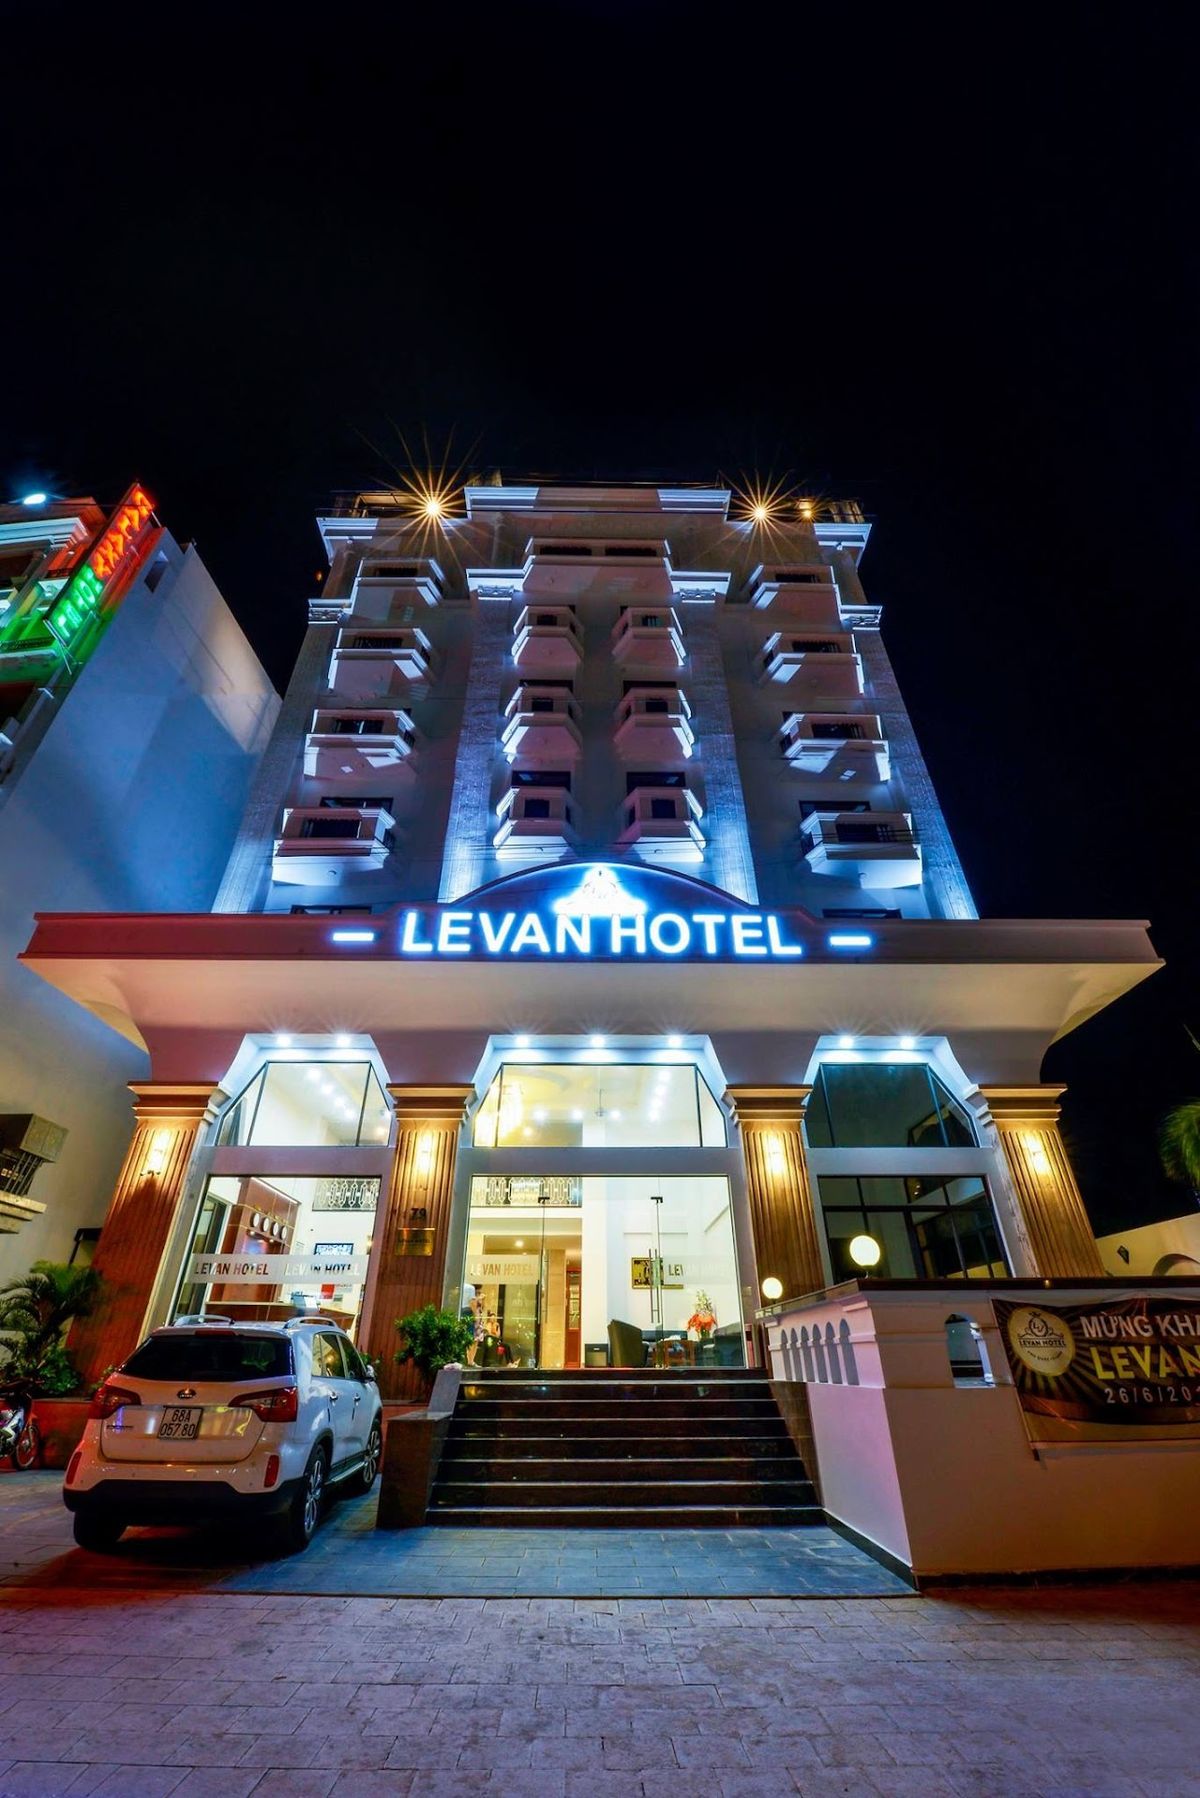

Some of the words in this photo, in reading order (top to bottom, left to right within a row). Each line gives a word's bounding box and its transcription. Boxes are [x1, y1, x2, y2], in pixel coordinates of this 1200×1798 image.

[54, 566, 104, 638] HOTEL
[402, 911, 591, 953] LEVAN
[611, 913, 802, 955] HOTEL
[194, 1262, 231, 1275] LEVAN
[233, 1262, 269, 1275] HOTEL
[470, 1263, 502, 1276] LEVAN
[1080, 1311, 1153, 1338] MỪNG
[1042, 1339, 1066, 1347] HOTEL
[172, 1409, 192, 1422] 68A
